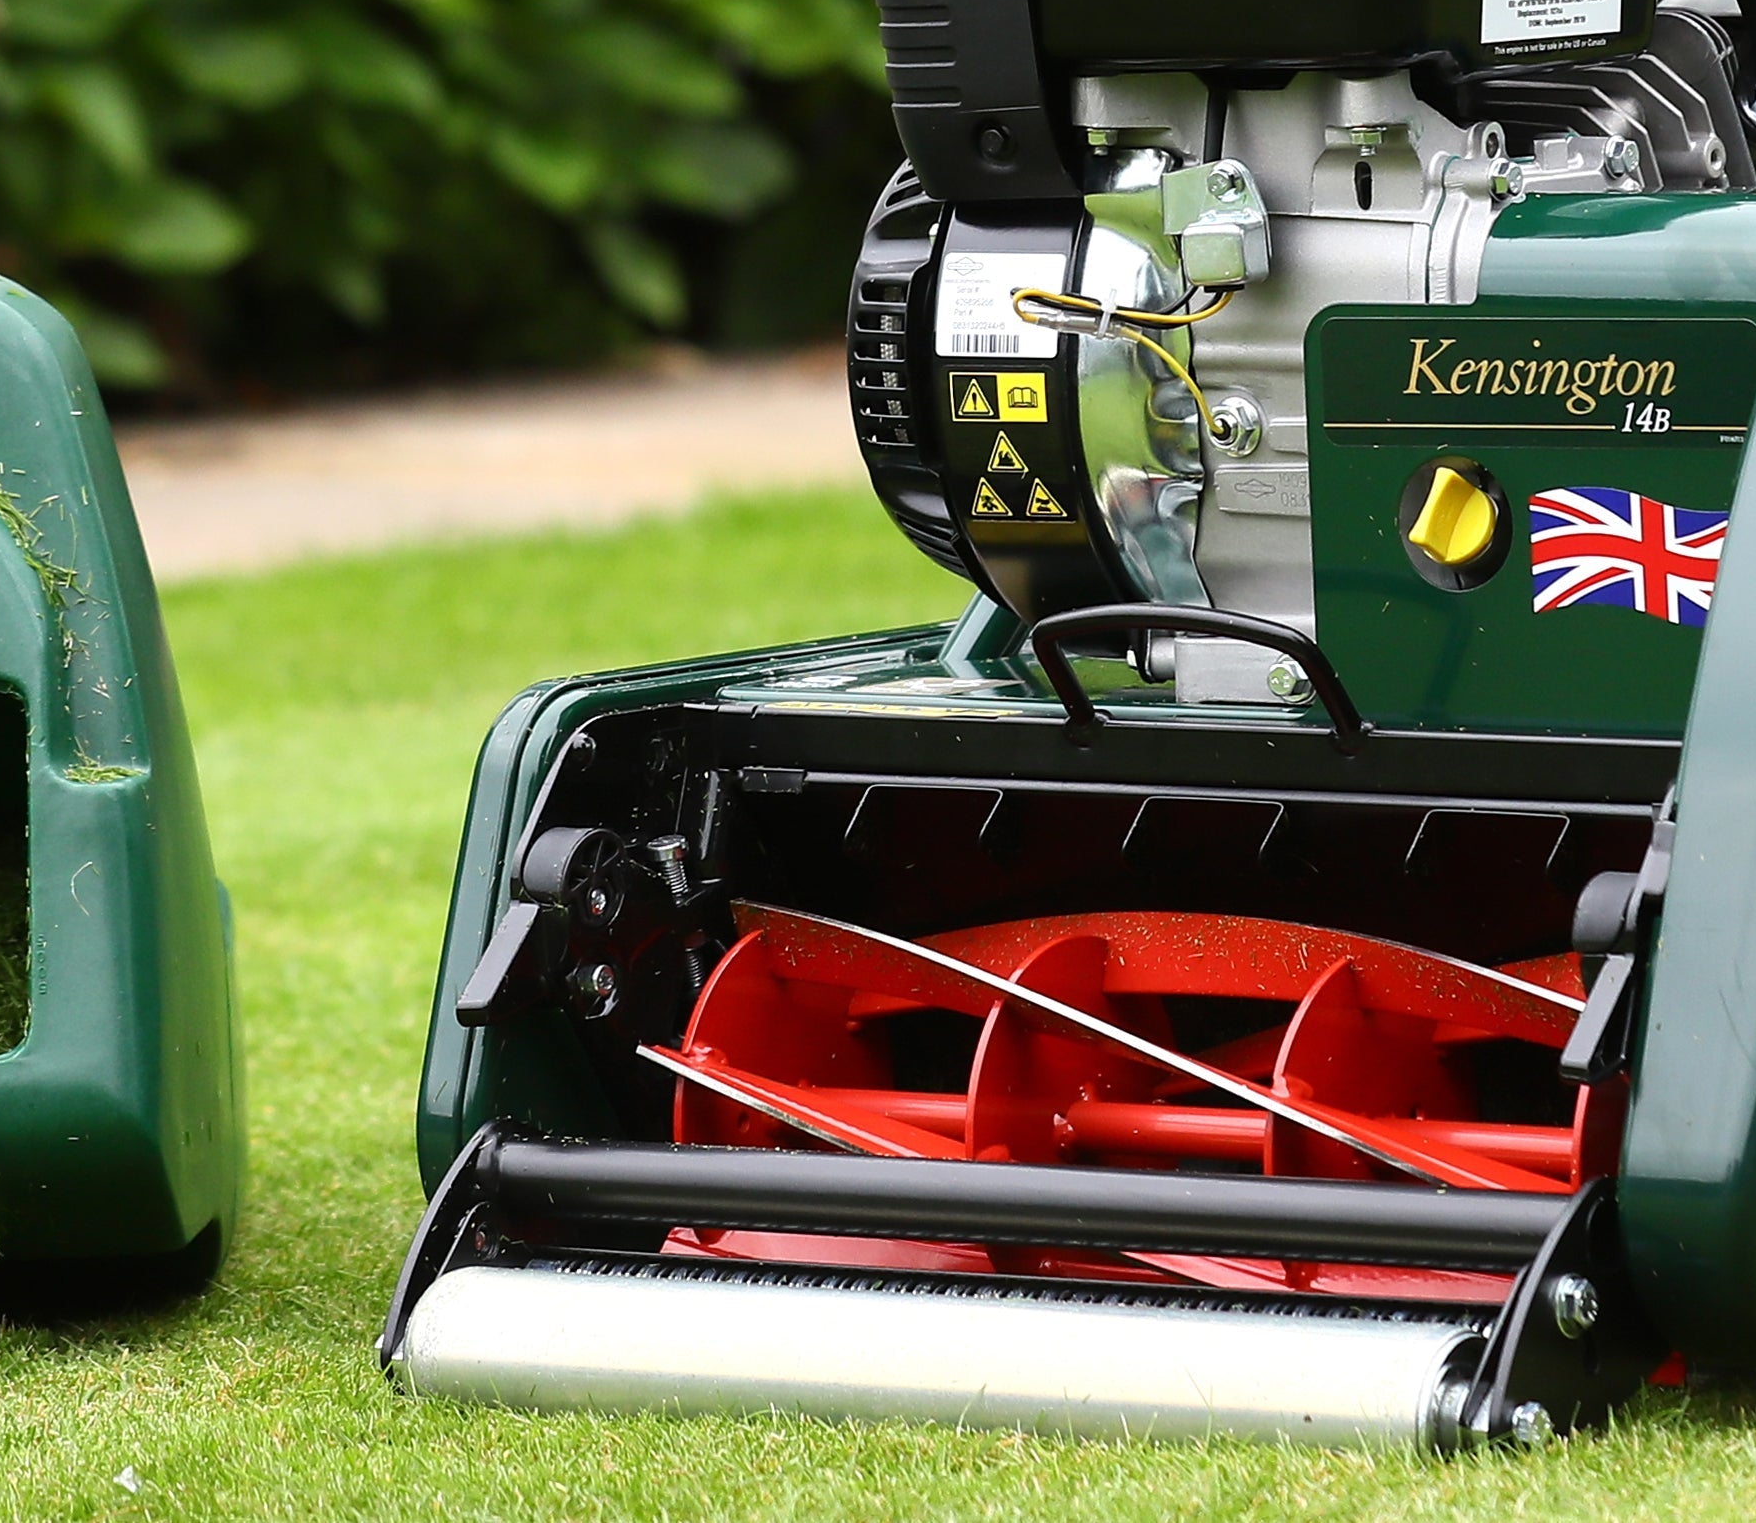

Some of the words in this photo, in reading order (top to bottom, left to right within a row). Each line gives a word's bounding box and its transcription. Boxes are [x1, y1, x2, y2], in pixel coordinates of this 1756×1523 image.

[1403, 338, 1678, 416] Kensington
[1620, 402, 1671, 433] 14B
[1281, 492, 1310, 508] 083
